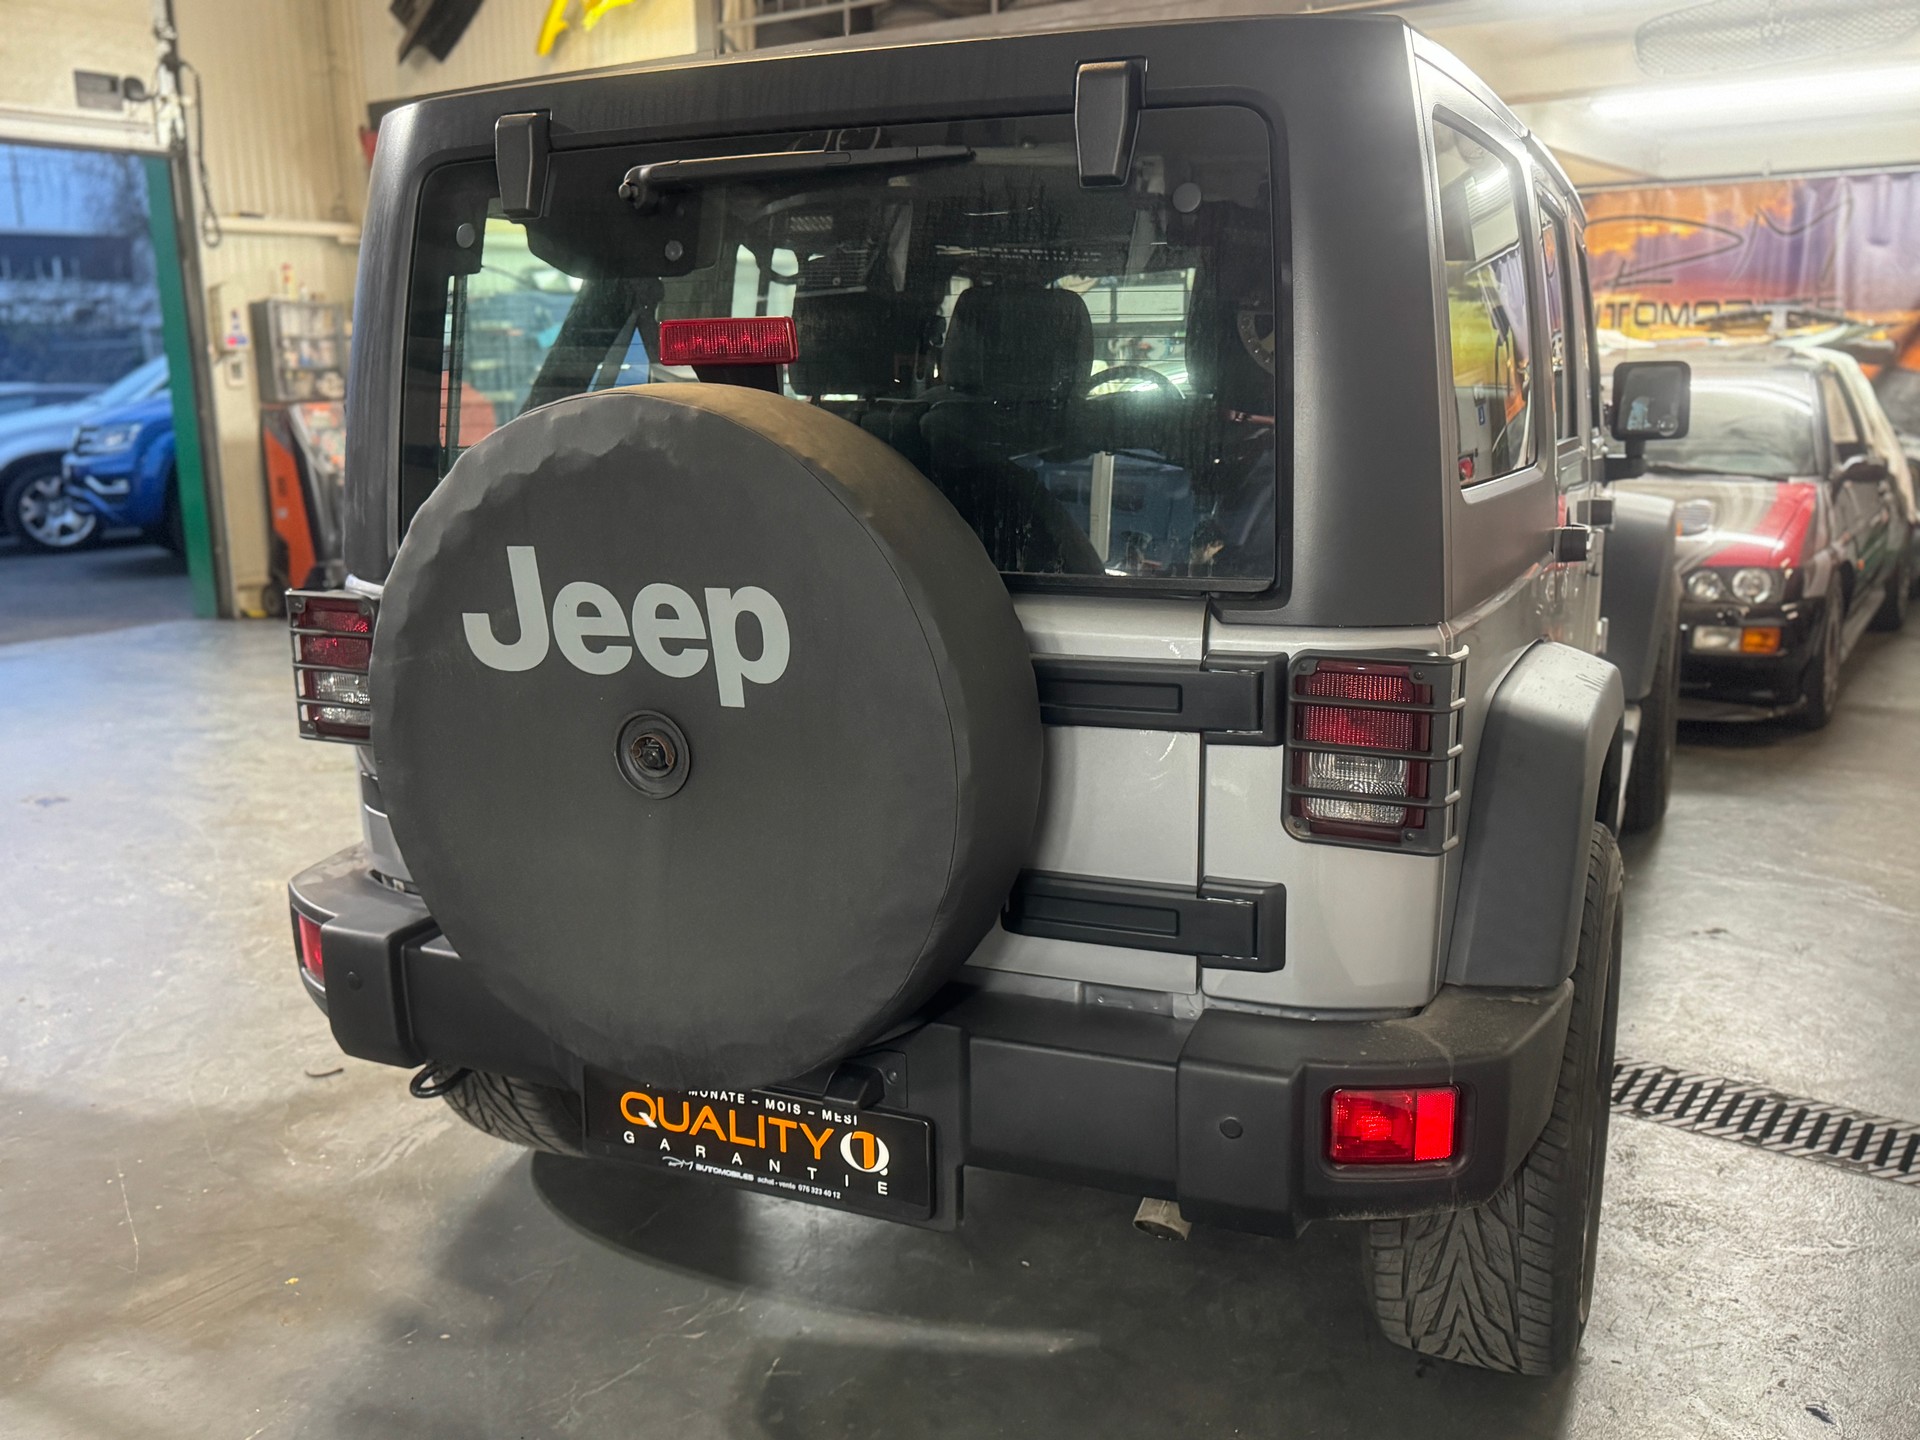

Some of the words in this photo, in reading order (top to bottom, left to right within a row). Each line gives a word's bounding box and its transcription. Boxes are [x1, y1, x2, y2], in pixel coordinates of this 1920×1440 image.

[461, 545, 791, 708] Jeep
[765, 1098, 801, 1116] MOIS
[821, 1109, 858, 1126] MESI
[623, 1130, 888, 1196] GARANTIE
[695, 1163, 754, 1181] AUTOMOBILES
[832, 1192, 841, 1200] 12
